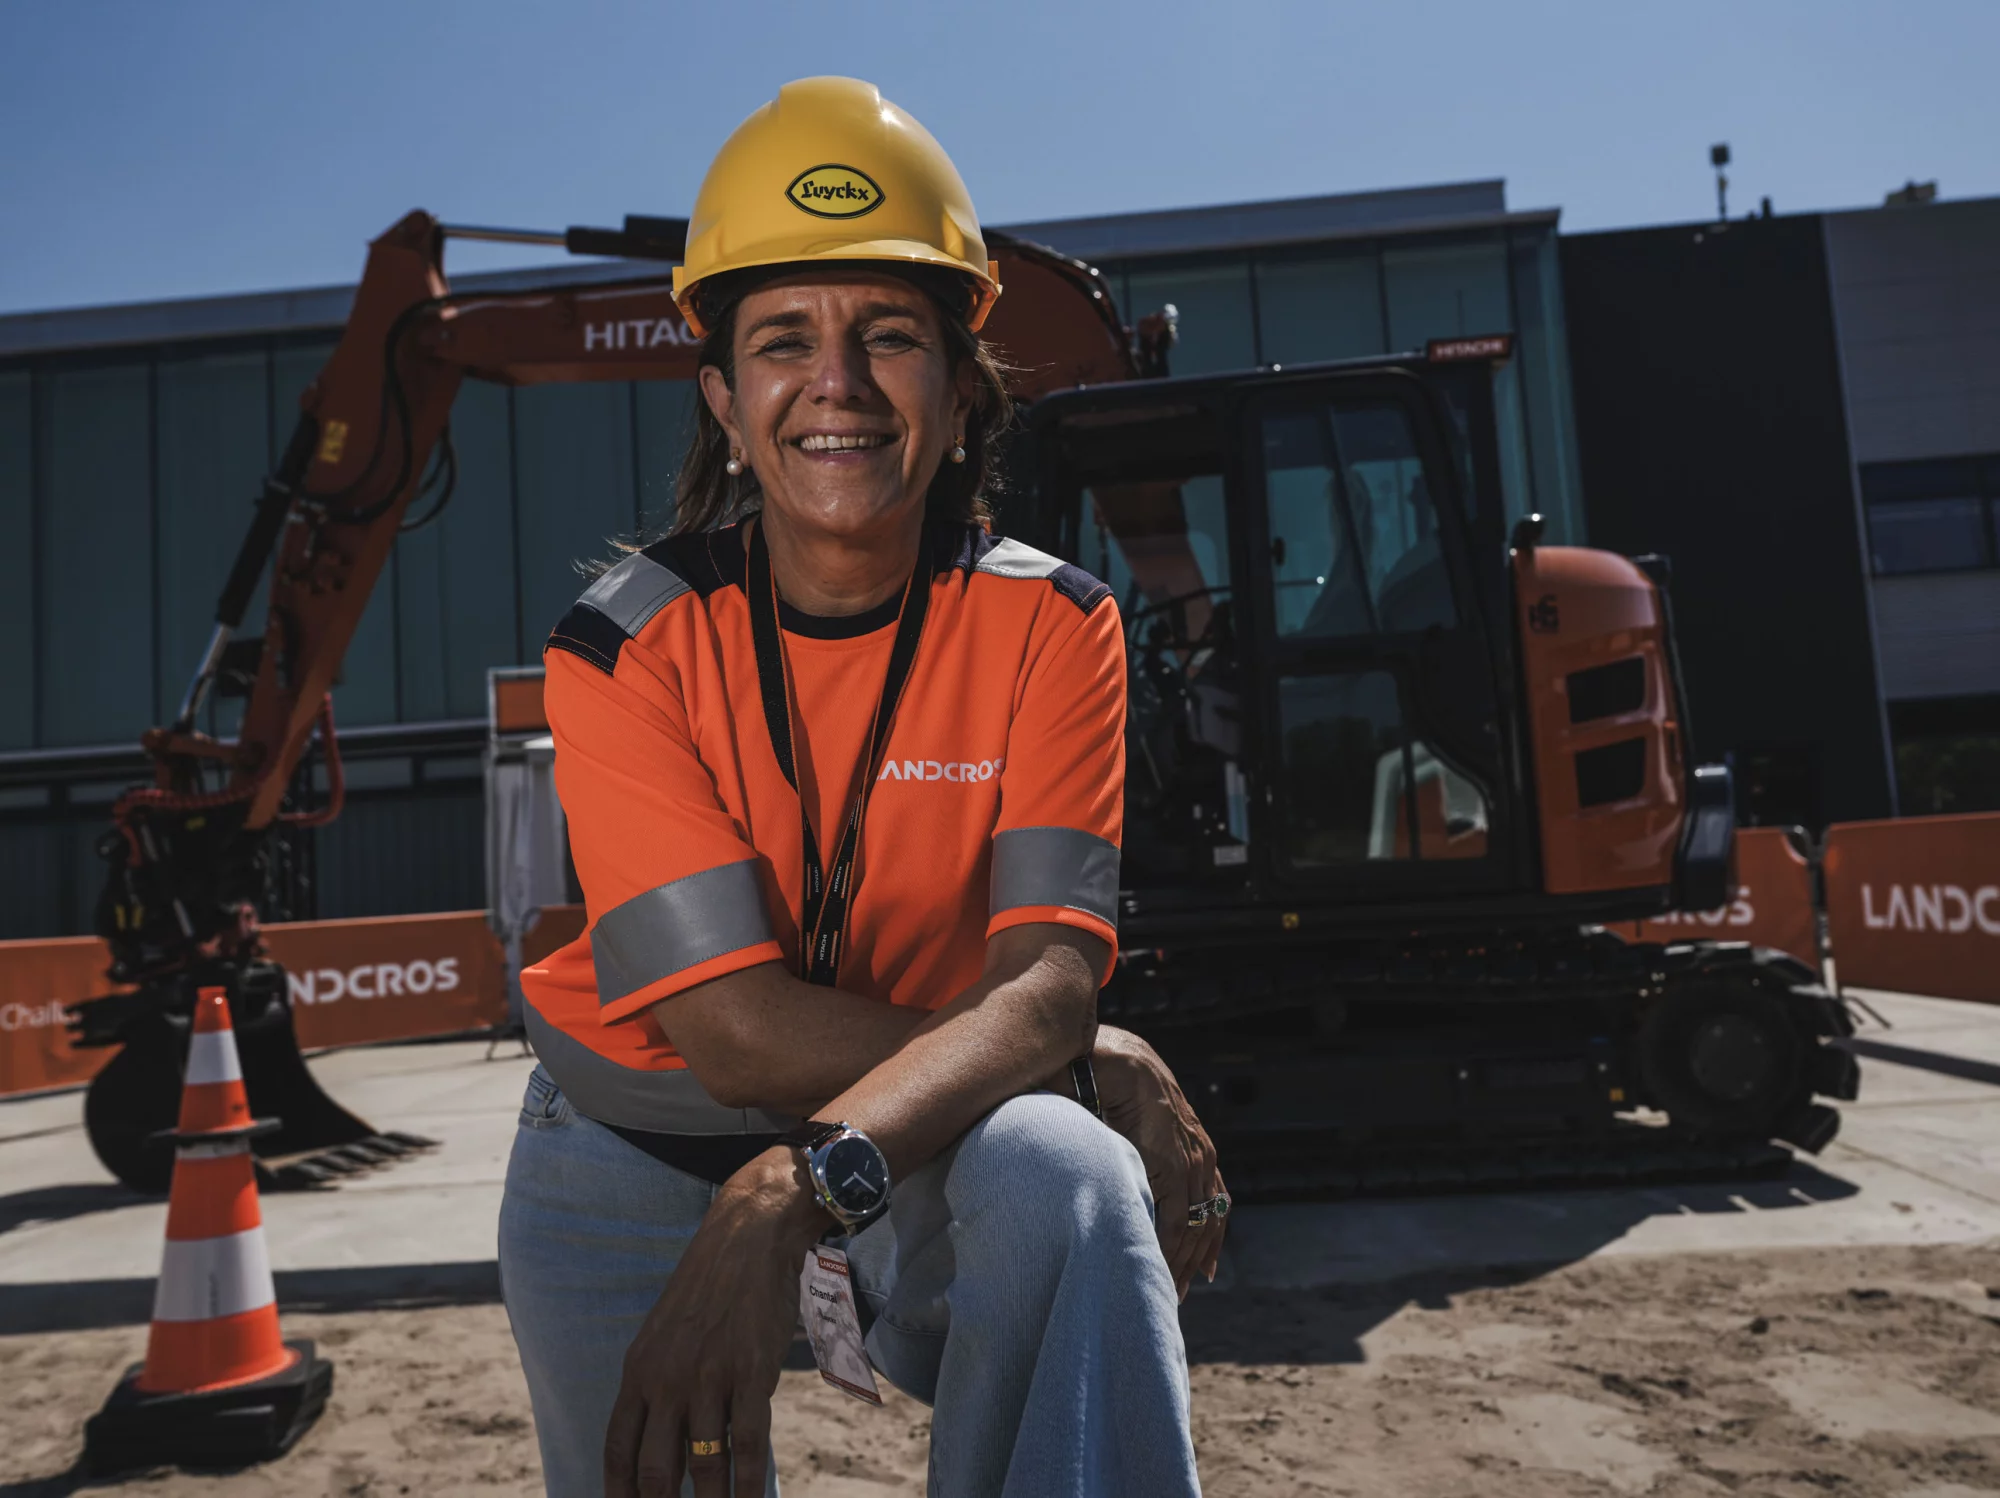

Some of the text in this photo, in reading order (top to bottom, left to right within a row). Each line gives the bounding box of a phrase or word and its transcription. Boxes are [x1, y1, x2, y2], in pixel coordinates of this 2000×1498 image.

[801, 180, 869, 201] Luyckx
[1435, 336, 1503, 359] HITACHI
[833, 866, 843, 892] HITACHI
[1860, 882, 2000, 937] LANDC
[819, 934, 828, 961] HITACHI
[286, 956, 460, 1007] NDCROS
[809, 1285, 838, 1304] Chantal
